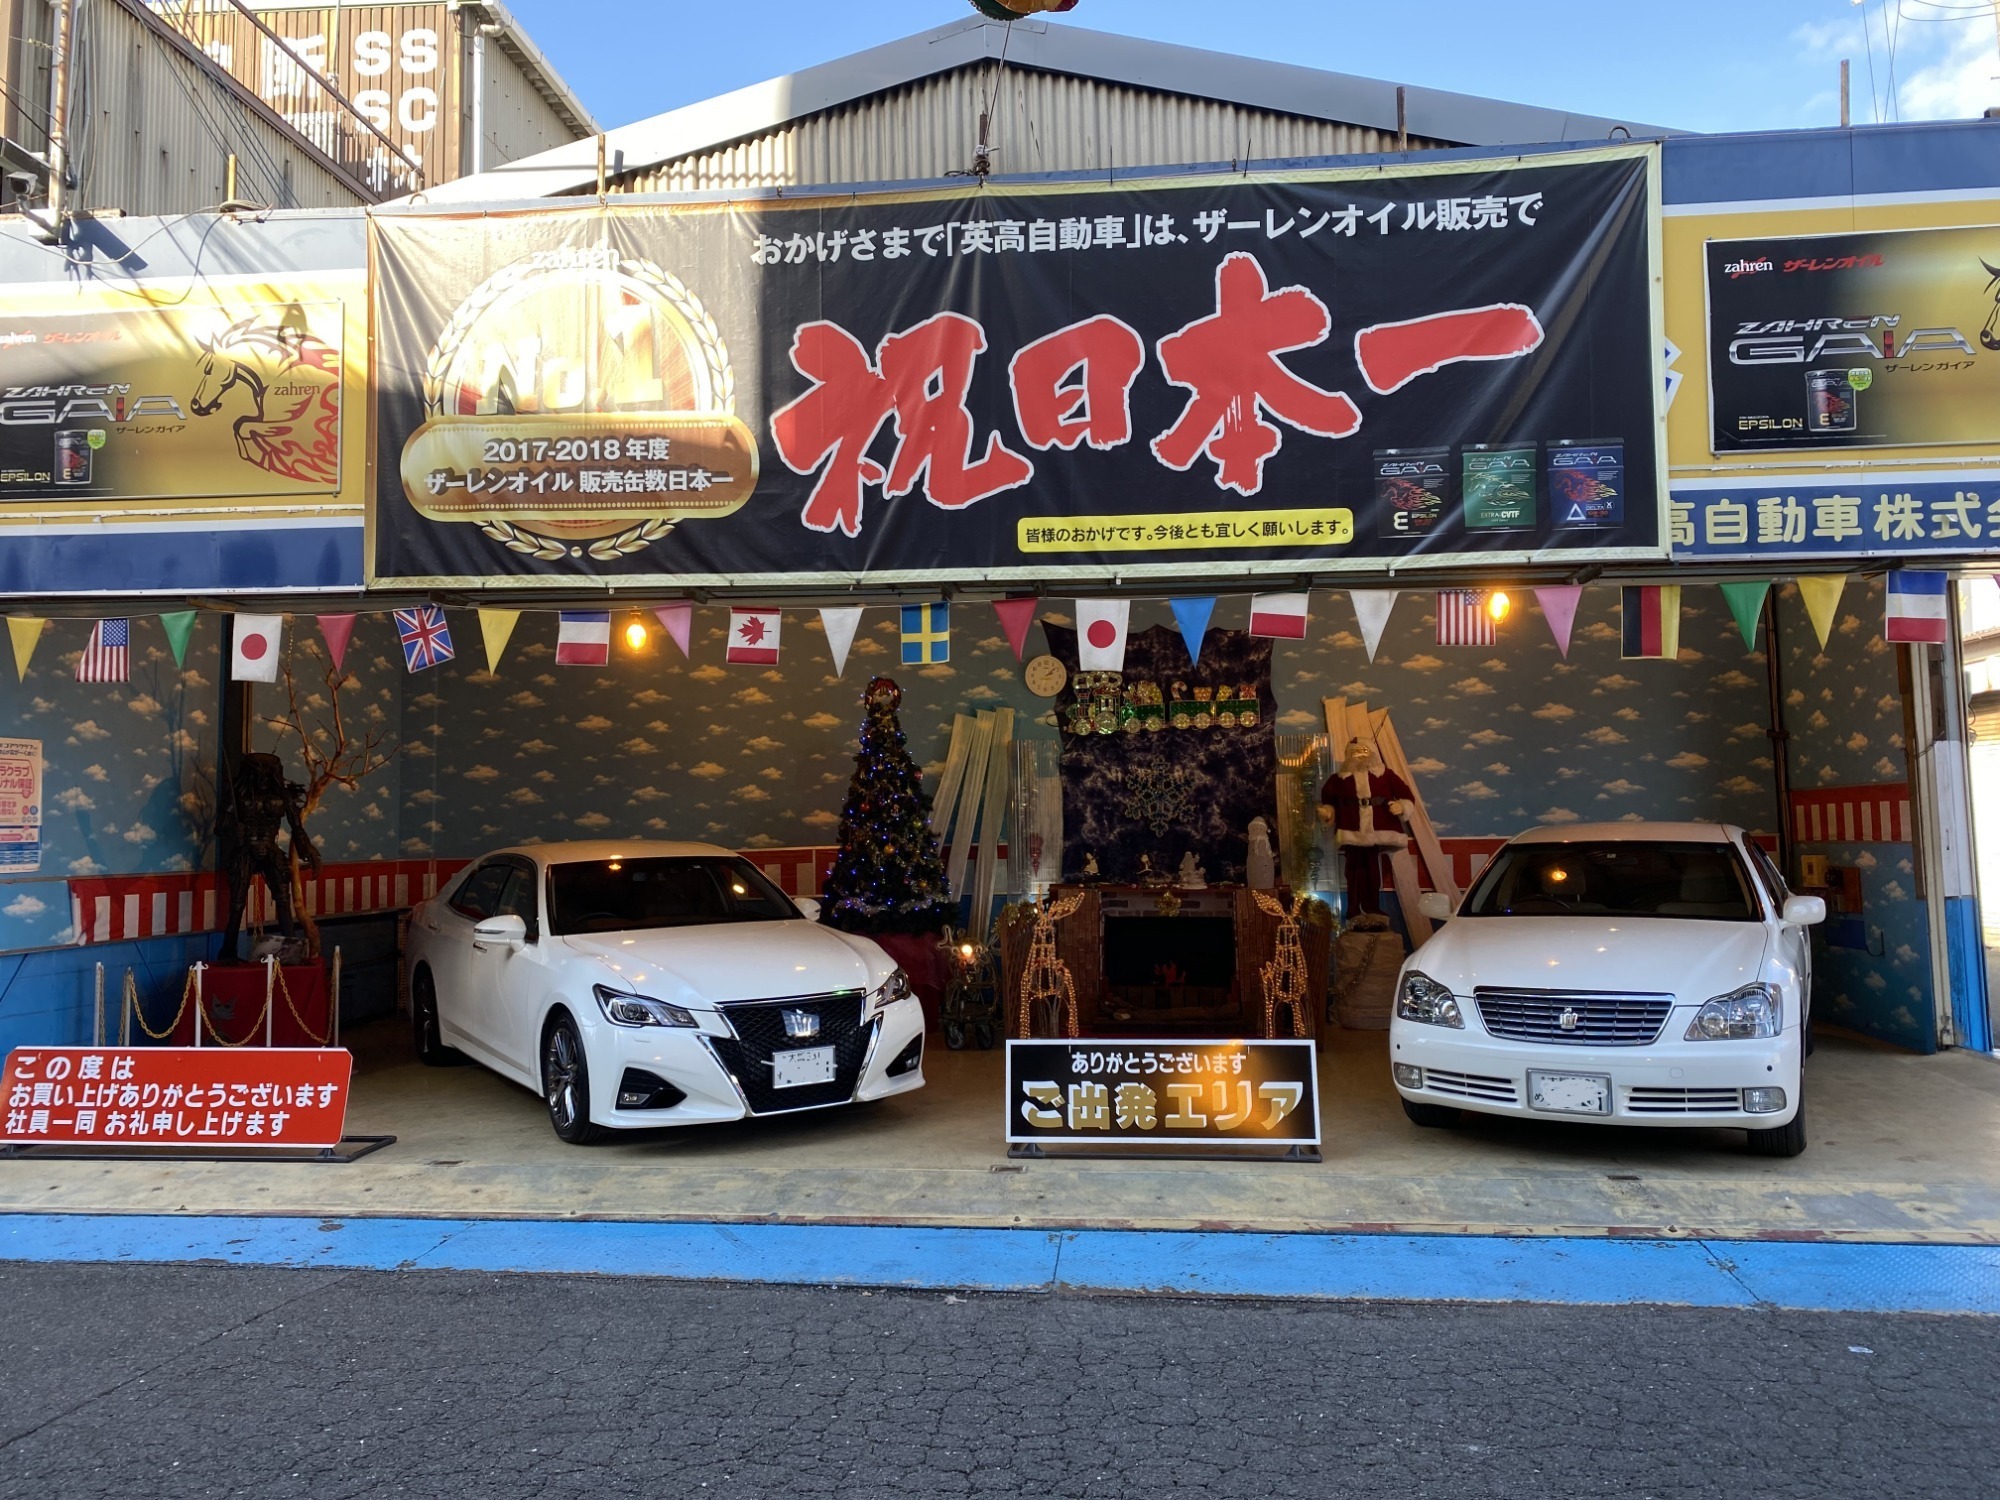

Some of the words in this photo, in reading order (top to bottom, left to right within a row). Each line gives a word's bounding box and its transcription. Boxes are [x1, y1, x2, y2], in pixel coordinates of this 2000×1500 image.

[353, 28, 438, 76] SS
[750, 191, 1544, 266] おかげさまで「英高自動車」は、ザーレンオイル販売で
[1724, 258, 1774, 274] zahren
[1783, 254, 1886, 272] ザーレンオイル
[1735, 314, 1901, 336] ZAHREN
[1729, 327, 1977, 366] GAIA
[3, 383, 131, 399] ZAHREN
[273, 382, 321, 397] zahren
[770, 250, 1546, 539] 祝日本一
[0, 395, 188, 425] GAIA
[1738, 417, 1804, 431] EPSILON
[482, 438, 622, 463] 2017-2018
[625, 437, 671, 462] 年度
[0, 472, 51, 482] EPSILON
[424, 471, 574, 496] ザーレンオイル
[579, 468, 734, 494] 販売缶数日本一
[1026, 519, 1349, 543] 皆様のおかげです。今後とも宜しく願いします。
[1070, 1052, 1247, 1075] ありがとうございます
[8, 1082, 338, 1109] お買い上げありがとうございます
[1021, 1080, 1304, 1131] ご出発エリア
[4, 1109, 96, 1135] 社員一同
[104, 1110, 291, 1136] お礼申し上げます
